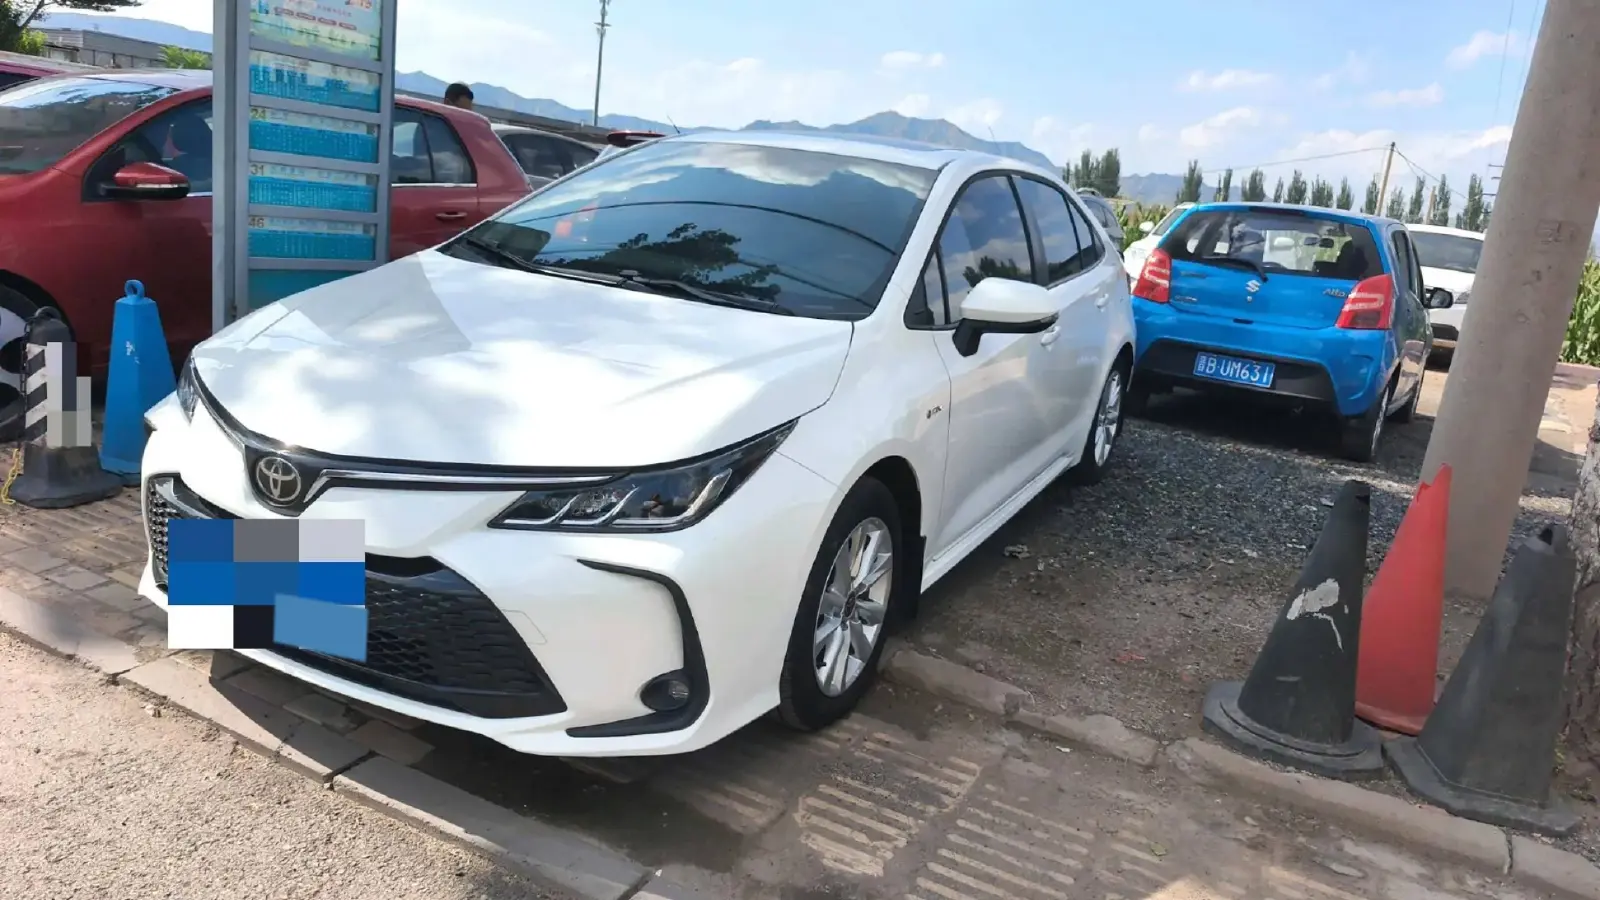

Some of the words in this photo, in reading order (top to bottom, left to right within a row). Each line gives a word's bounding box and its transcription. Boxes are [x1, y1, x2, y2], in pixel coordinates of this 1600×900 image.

[251, 108, 267, 120] 24
[250, 164, 265, 176] 31
[248, 216, 265, 229] 46
